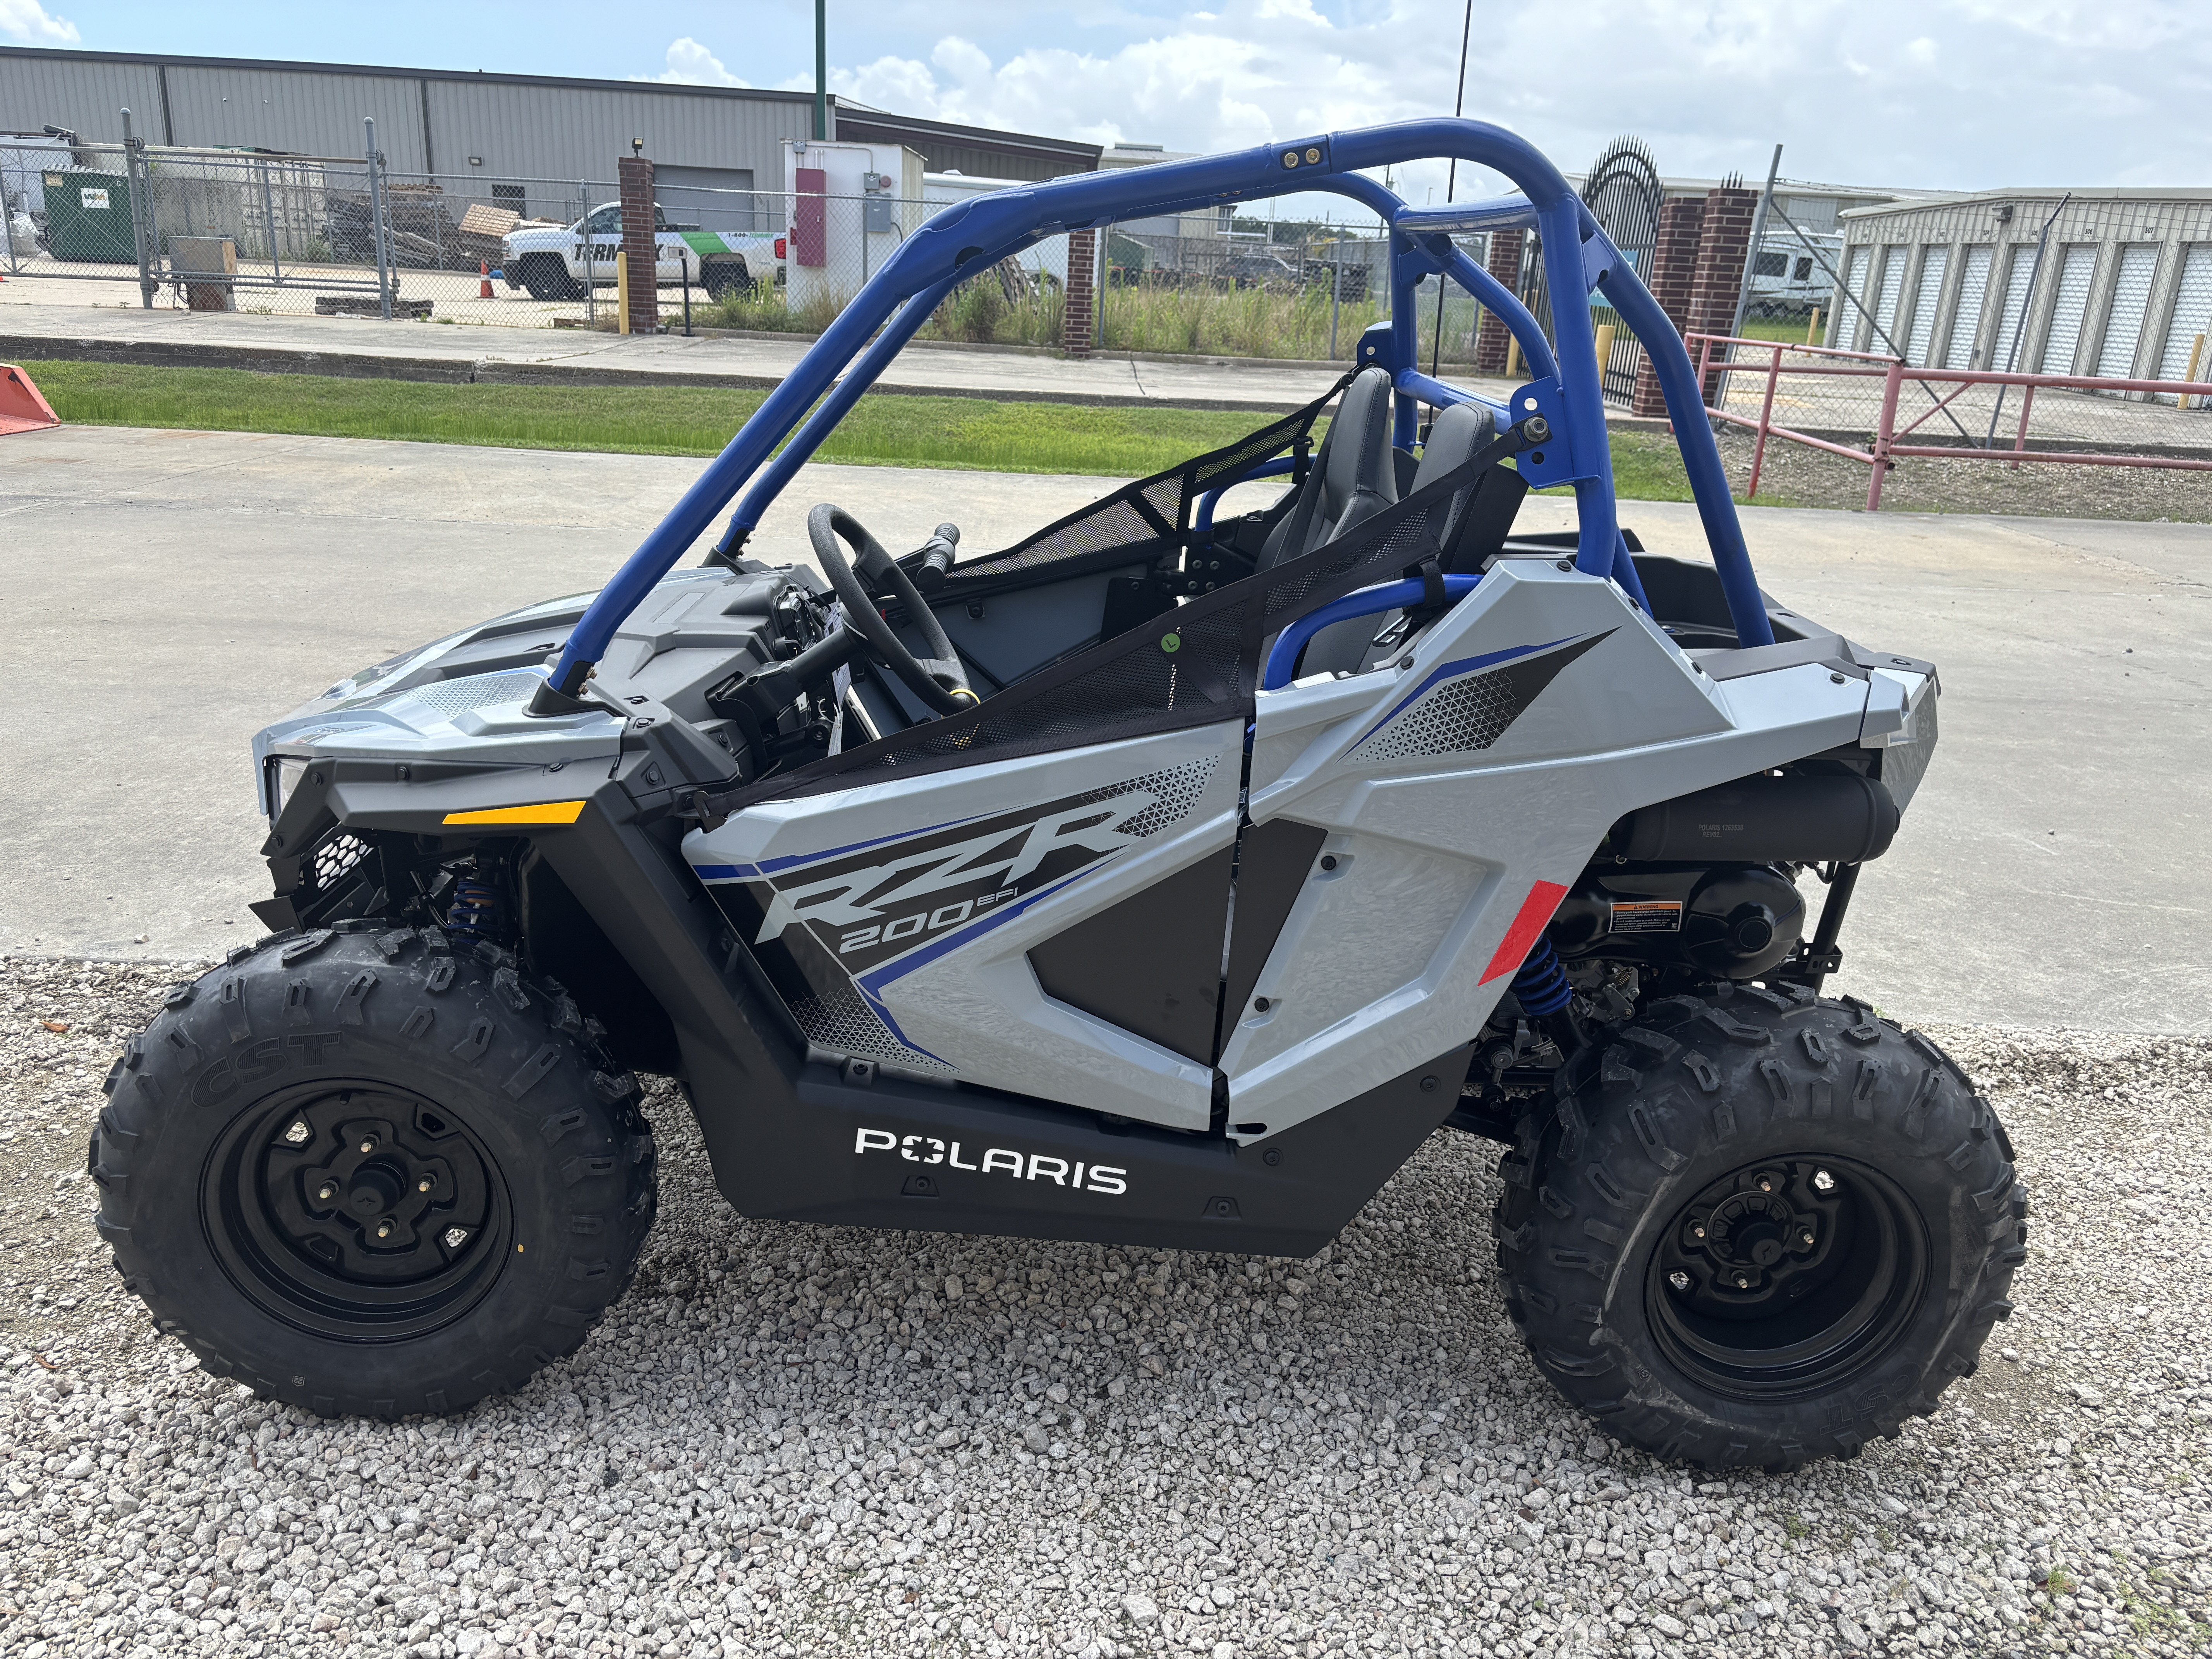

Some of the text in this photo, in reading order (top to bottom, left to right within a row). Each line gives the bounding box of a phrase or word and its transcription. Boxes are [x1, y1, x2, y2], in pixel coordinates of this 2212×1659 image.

[1166, 639, 1176, 648] L
[754, 790, 1159, 945] RZR
[839, 887, 1018, 954] 200 EFI
[191, 1031, 342, 1108] CST
[855, 1128, 1127, 1195] POLARIS
[1820, 1362, 1922, 1435] CST
